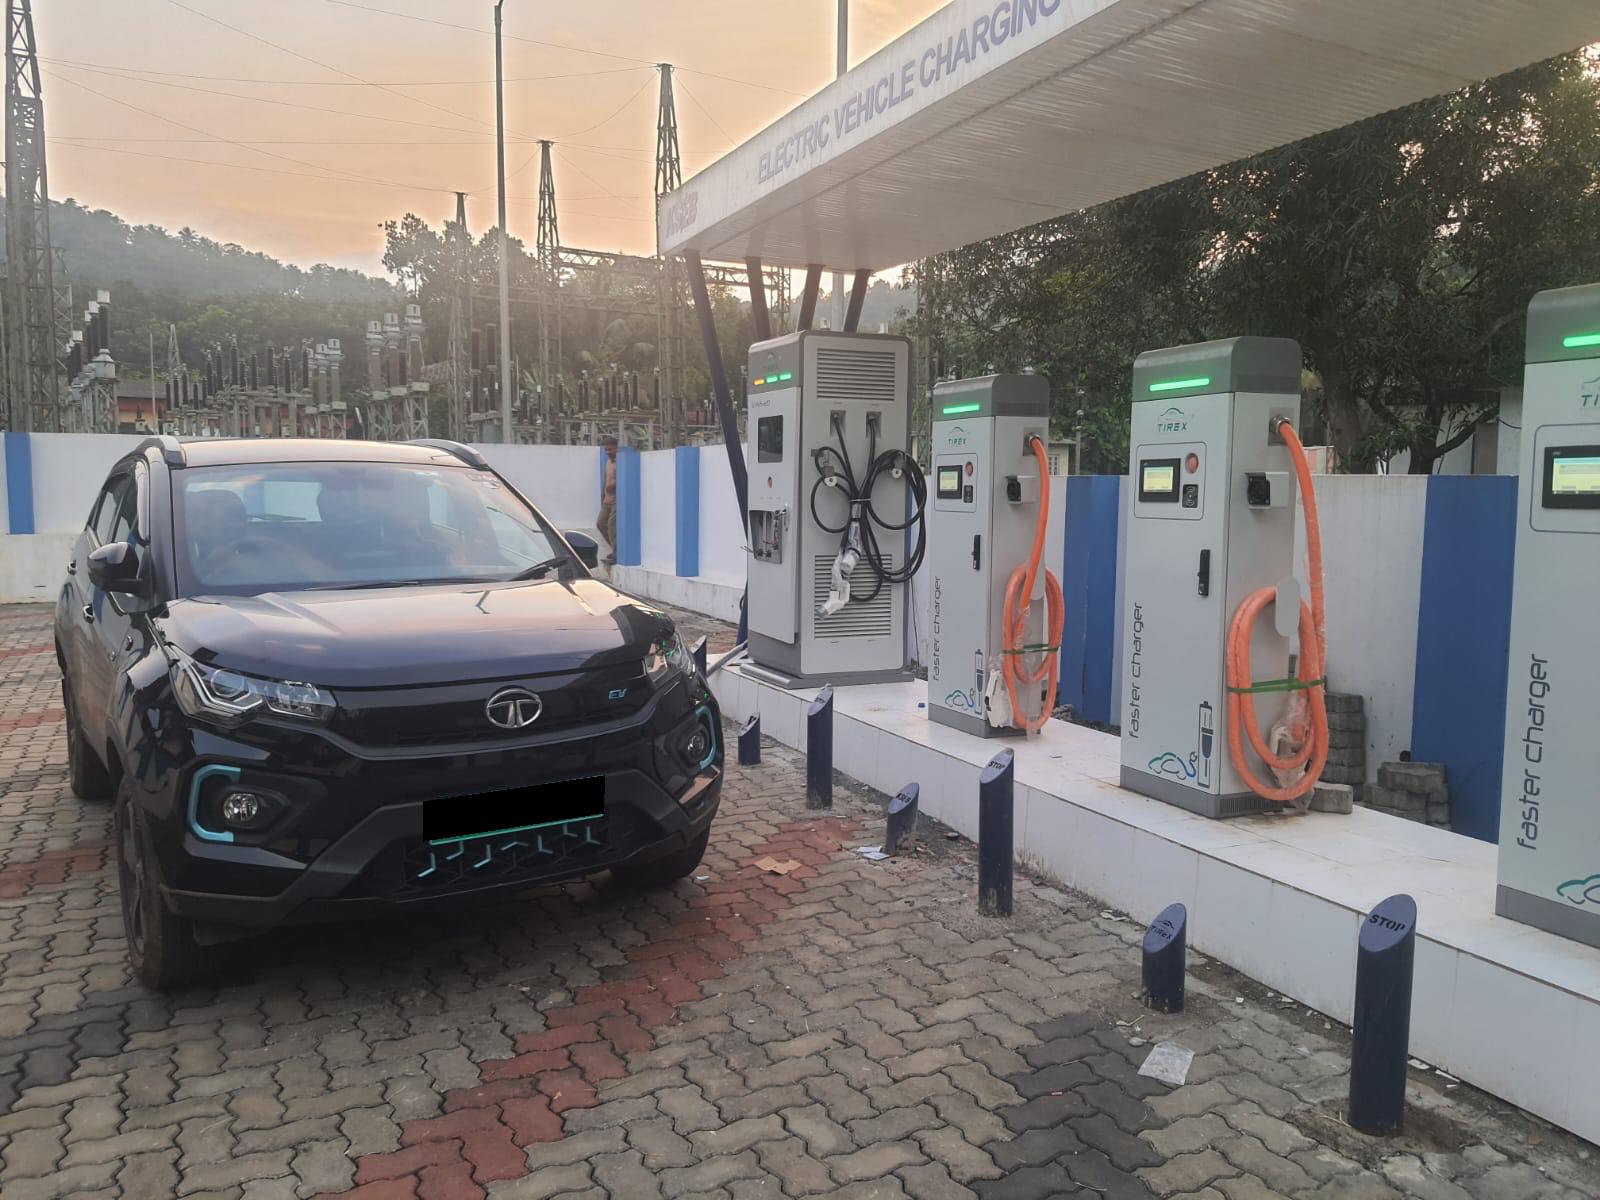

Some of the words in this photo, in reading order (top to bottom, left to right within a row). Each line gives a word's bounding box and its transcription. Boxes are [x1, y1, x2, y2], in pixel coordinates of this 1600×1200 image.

[758, 114, 830, 185] ELECTRIC
[834, 60, 916, 139] VEHICLE
[1158, 422, 1188, 433] TIREX
[933, 576, 941, 635] charger
[1131, 602, 1144, 678] charger
[608, 688, 627, 700] EV
[1129, 682, 1140, 739] faster
[1522, 653, 1551, 764] charger
[1517, 769, 1541, 850] faster
[1369, 914, 1406, 932] STOP
